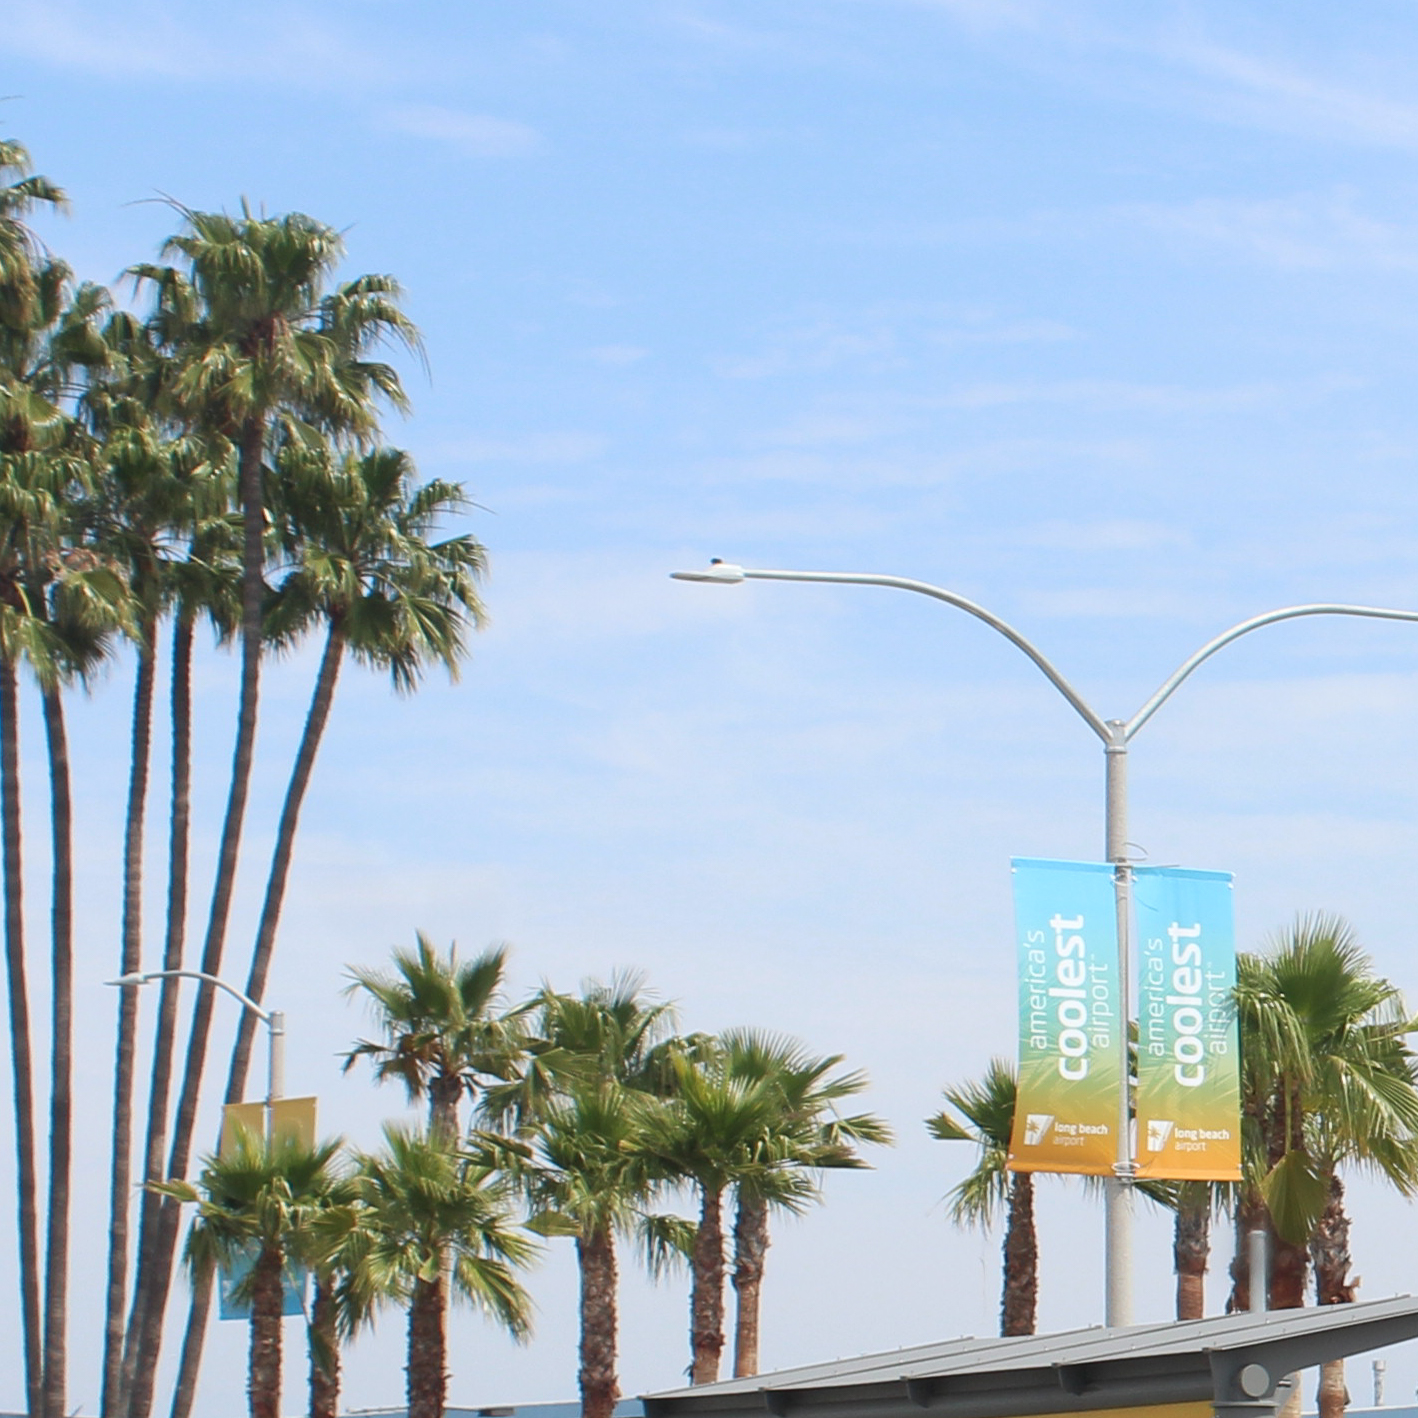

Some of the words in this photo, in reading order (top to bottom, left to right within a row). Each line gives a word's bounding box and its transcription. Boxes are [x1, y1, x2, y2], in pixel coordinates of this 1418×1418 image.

[1023, 929, 1049, 1051] america's
[1048, 913, 1090, 1081] coolest
[1088, 963, 1116, 1049] airport
[1144, 938, 1166, 1057] america's
[1166, 921, 1206, 1087] coolest
[1052, 1134, 1085, 1148] airport
[1054, 1121, 1077, 1137] long
[1078, 1122, 1109, 1136] beach
[1173, 1140, 1208, 1153] airport
[1174, 1125, 1199, 1142] long
[1199, 1127, 1231, 1141] beach
